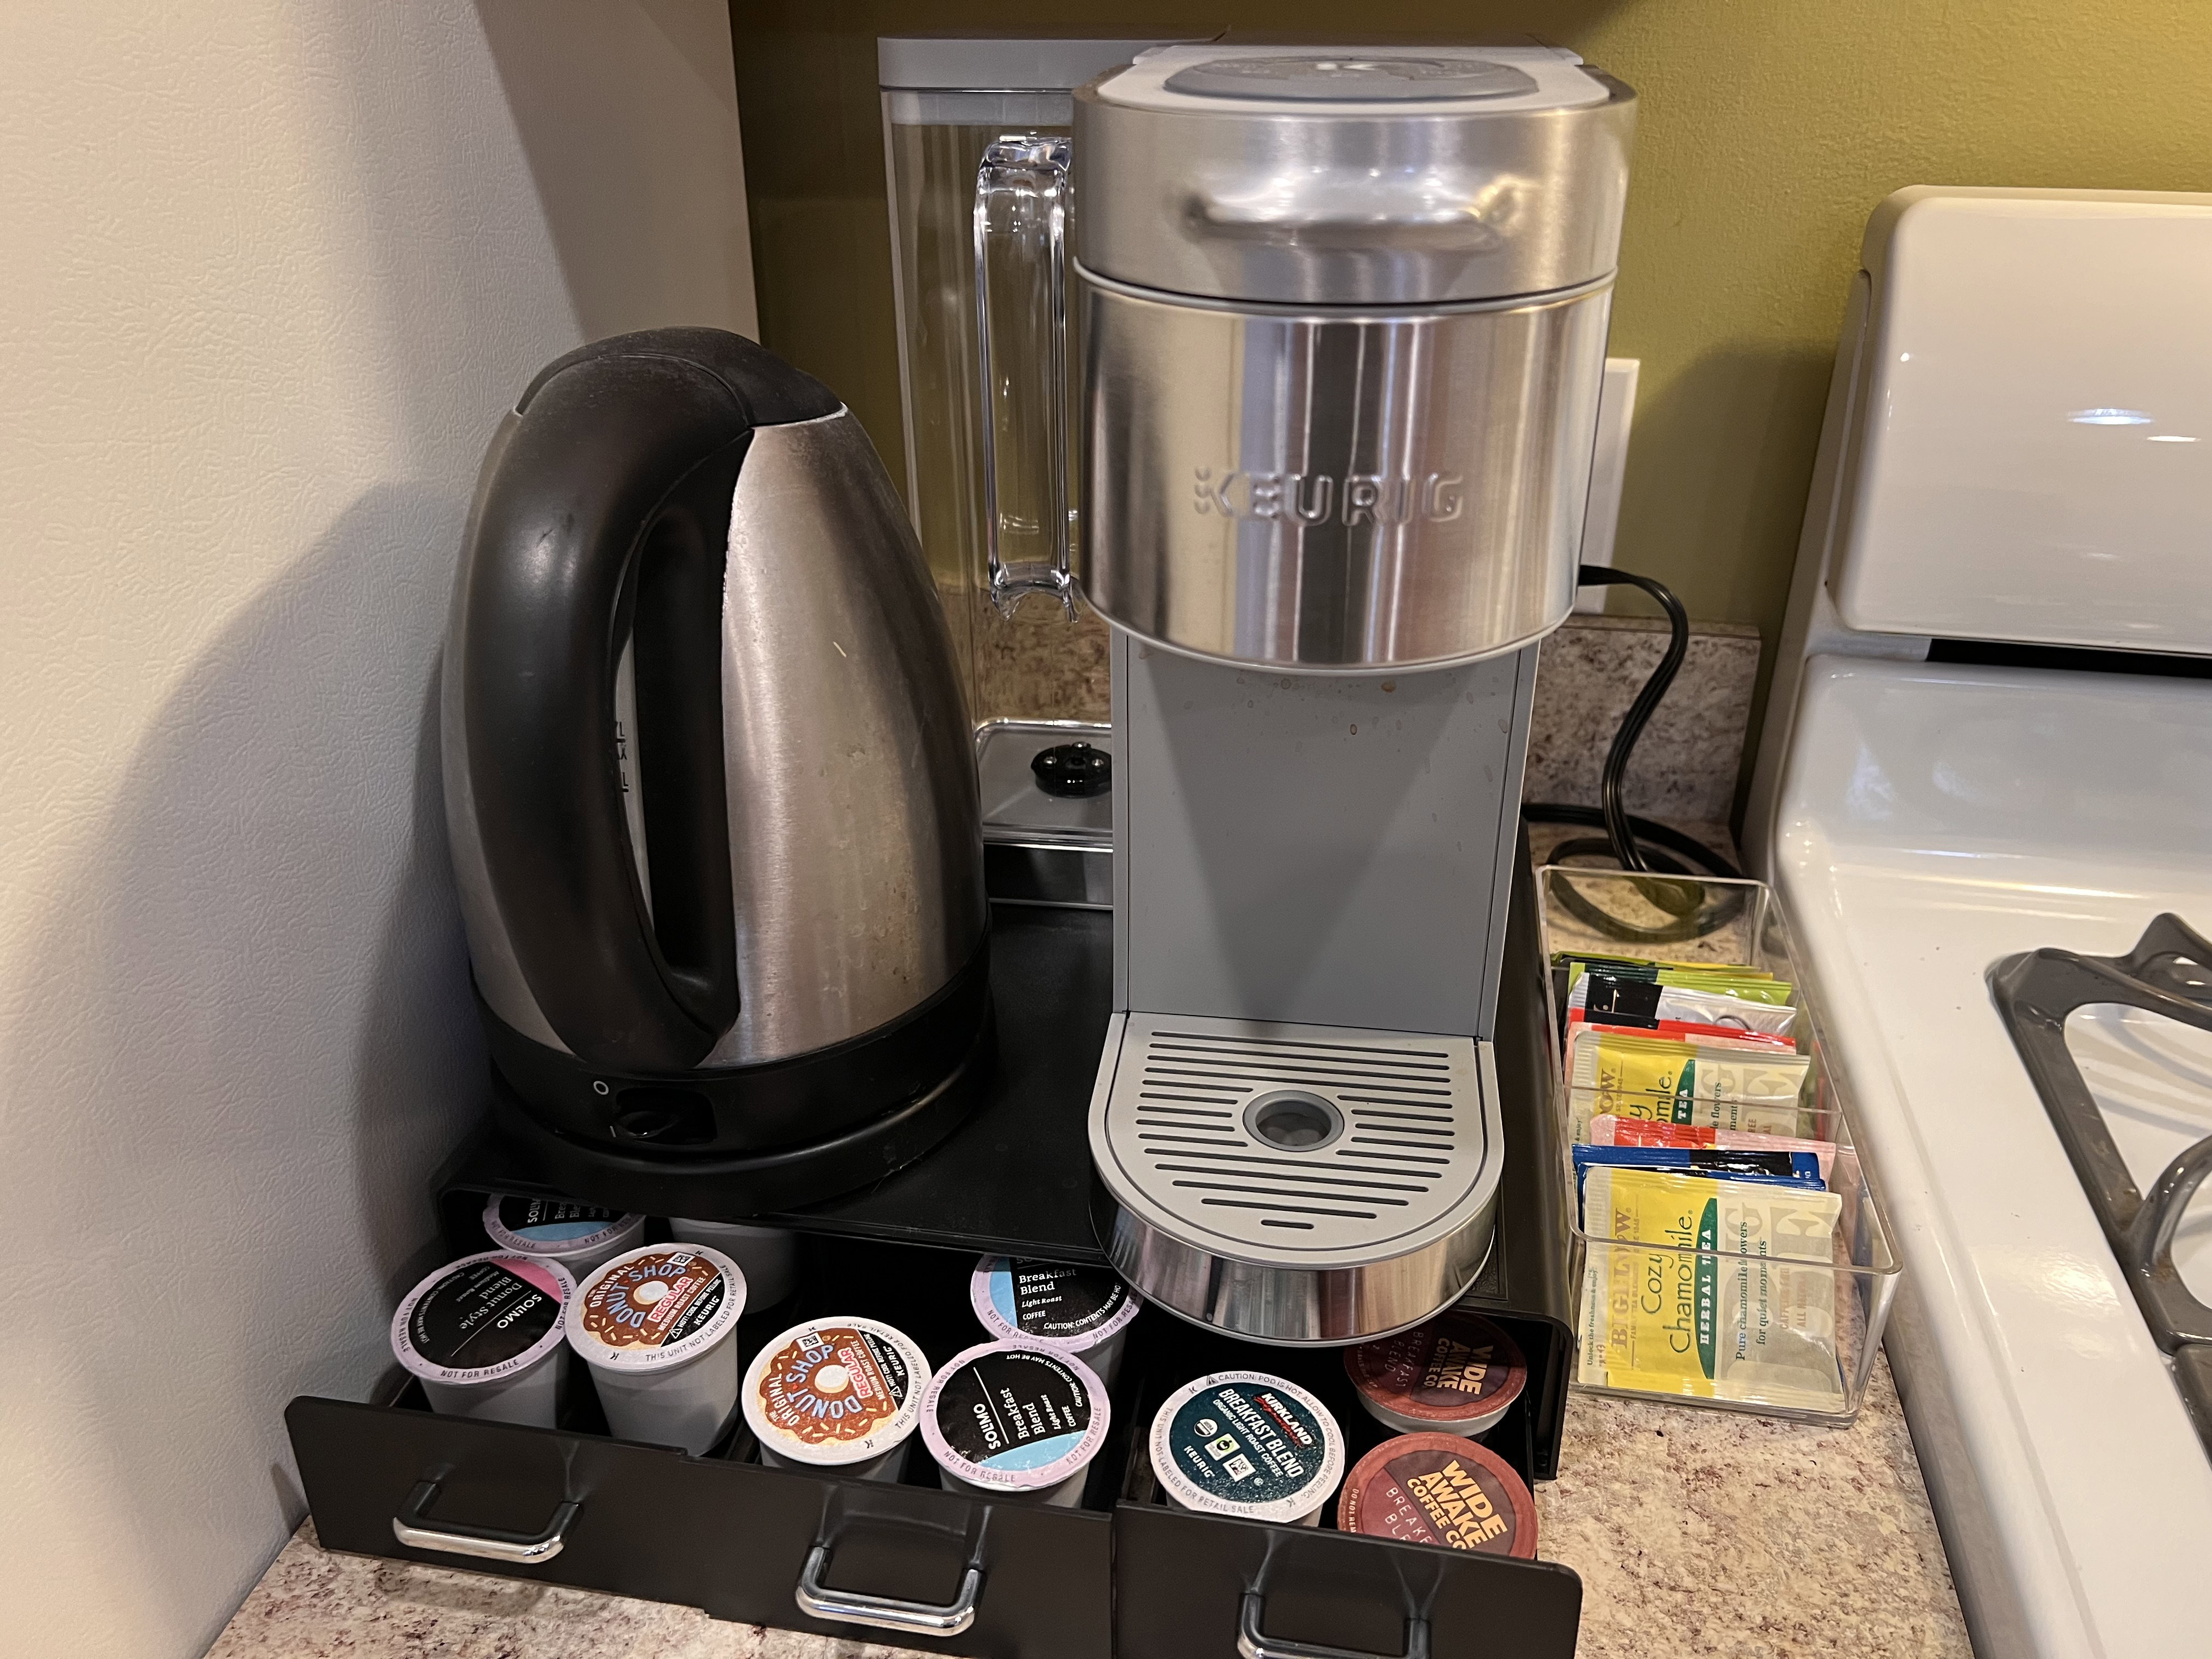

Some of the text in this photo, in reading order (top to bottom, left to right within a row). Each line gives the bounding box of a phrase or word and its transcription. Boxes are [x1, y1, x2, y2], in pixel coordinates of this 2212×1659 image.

[1195, 467, 1463, 525] KEURIG
[1678, 1089, 1688, 1119] TEA
[479, 1277, 512, 1300] Blend
[590, 1265, 634, 1308] ORIGINAL
[1019, 1268, 1077, 1284] Breakfast
[1020, 1281, 1055, 1295] Blend
[1114, 1284, 1122, 1293] HO
[1641, 1253, 1674, 1314] Cozy
[1701, 1229, 1711, 1345] HERBAL TEA
[459, 1283, 522, 1329] Donut Style
[606, 1263, 686, 1328] DONUT SHOP
[651, 1278, 692, 1321] REGULAR
[693, 1295, 720, 1325] KEURIG
[1022, 1295, 1062, 1307] Light Roast
[1103, 1300, 1114, 1311] MAY
[1111, 1292, 1119, 1301] BE
[1736, 1266, 1747, 1329] chamomile
[497, 1294, 541, 1329] SOLIMO
[646, 1265, 737, 1362] THIS UNIT NOT LABELED FOR RETAIL SALE
[658, 1310, 676, 1331] MEDIUM
[675, 1292, 690, 1312] ROAST
[987, 1310, 1011, 1334] NOT FOR
[1023, 1310, 1046, 1320] COFFEE
[1075, 1308, 1105, 1327] CONTENTS
[1760, 1299, 1769, 1327] quiet
[1092, 1328, 1108, 1339] NOT
[1109, 1319, 1124, 1331] FOR
[1756, 1329, 1765, 1345] for
[883, 1345, 905, 1377] KEURIG
[896, 1340, 909, 1353] FOR
[1030, 1355, 1045, 1364] MAY
[1384, 1339, 1405, 1373] BLEND
[1395, 1331, 1424, 1387] BREAKFAST
[1428, 1337, 1451, 1373] COFFEE
[1736, 1333, 1745, 1360] Pure
[484, 1359, 519, 1375] RESALE
[838, 1347, 872, 1398] REGULAR
[850, 1340, 885, 1400] MEDIUM ROAST COFFEE
[904, 1351, 922, 1379] LABELED
[1044, 1361, 1073, 1384] CONTENTS
[1437, 1340, 1471, 1390] AWAKE
[1458, 1344, 1494, 1395] WIDE
[786, 1345, 863, 1419] DONUT SHOP
[913, 1381, 922, 1396] NOT
[926, 1359, 965, 1413] NOT FOR RESALE
[1069, 1383, 1083, 1408] CAUTION:
[1258, 1375, 1276, 1386] POD
[769, 1373, 800, 1426] ORIGINAL
[907, 1397, 919, 1413] UNIT
[1000, 1387, 1030, 1440] Breakfast
[1041, 1394, 1061, 1430] Light Roast
[1163, 1407, 1173, 1422] THIS
[1303, 1397, 1324, 1417] ALLOW
[769, 1410, 781, 1422] THE
[895, 1413, 911, 1429] THIS
[973, 1403, 1001, 1450] SOLIMO
[1023, 1402, 1046, 1435] Blend
[1062, 1406, 1076, 1427] COFFEE
[1158, 1421, 1167, 1440] UNIT
[1261, 1392, 1313, 1446] KIRKLAND
[1319, 1415, 1329, 1426] TO
[1065, 1407, 1102, 1465] NOT FOR RESALE
[1212, 1399, 1284, 1478] ORGANIC LIGHT ROAST COFFEE
[1218, 1389, 1304, 1479] BREAKFAST BLEND
[1326, 1426, 1335, 1448] COOL
[944, 1451, 1015, 1482] NOT FOR RESALE
[1157, 1455, 1181, 1487] LABELED
[1184, 1445, 1216, 1479] KEURIG
[1325, 1448, 1335, 1474] BEFORE
[1180, 1486, 1198, 1499] FOR
[1349, 1488, 1360, 1515] DO NOT
[1407, 1478, 1451, 1530] COFFEE
[1442, 1459, 1508, 1539] WIDE
[1231, 1505, 1254, 1514] SALE
[1418, 1471, 1488, 1549] AWAKE
